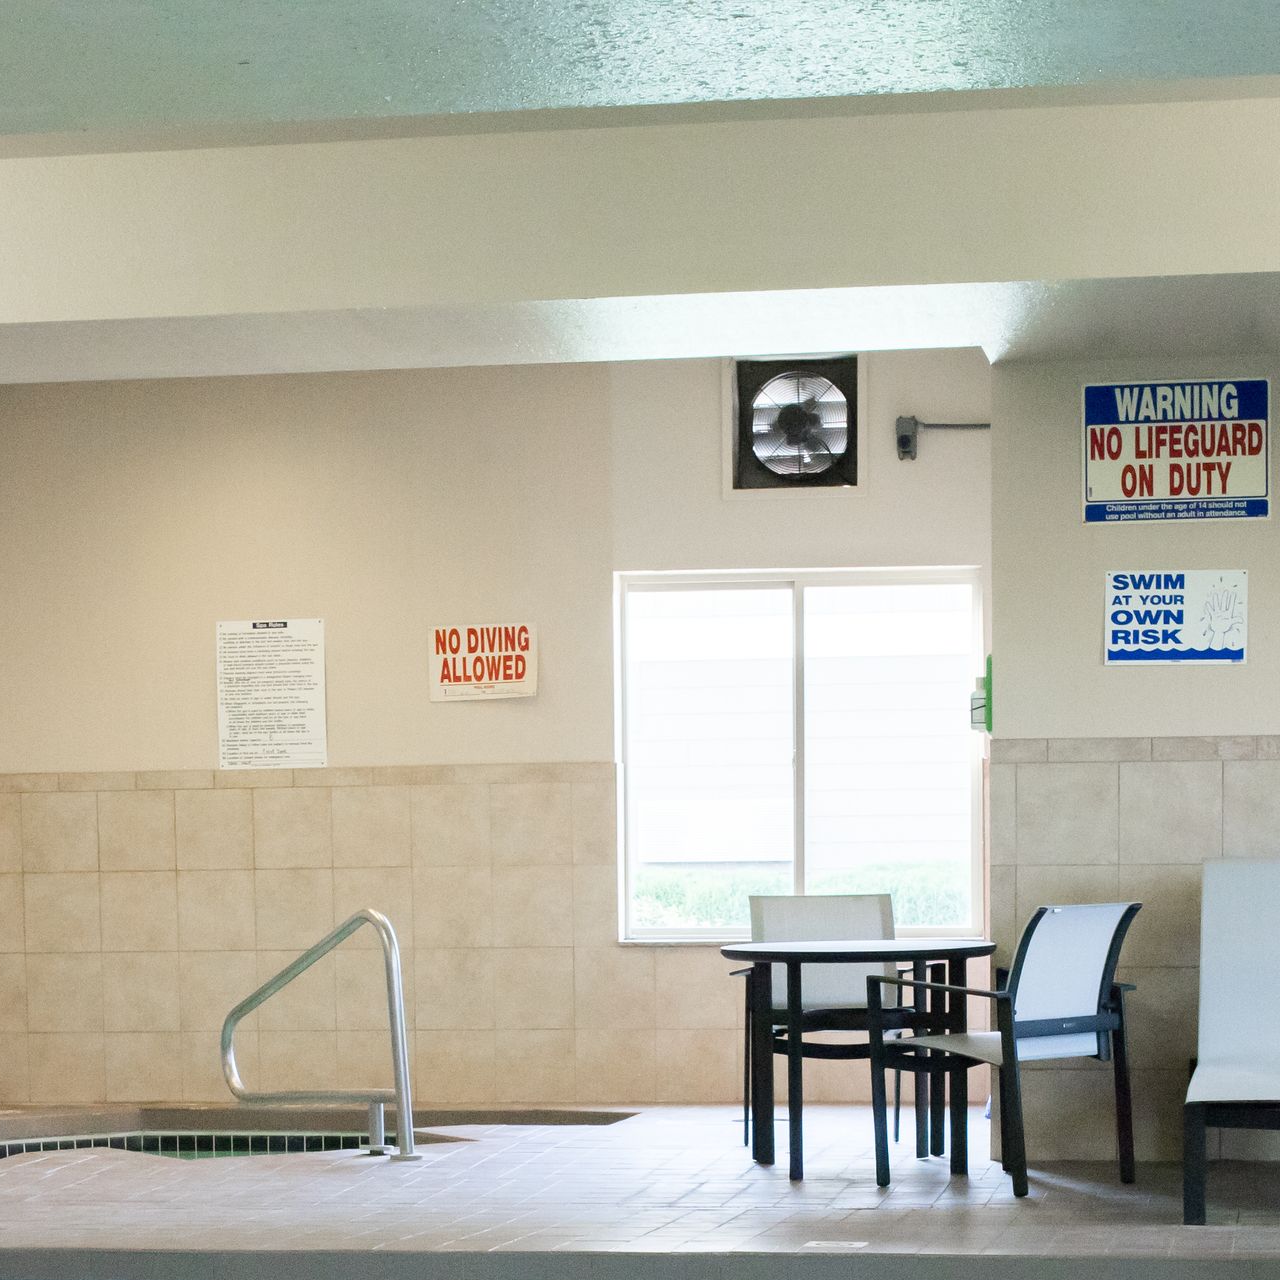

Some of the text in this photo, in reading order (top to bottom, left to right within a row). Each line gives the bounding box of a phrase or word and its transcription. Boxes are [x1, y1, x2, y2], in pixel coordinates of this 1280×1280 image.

[1114, 384, 1239, 422] WARNING
[1090, 423, 1263, 461] NO LIFEGUARD
[1121, 461, 1232, 498] ON DUTY
[1105, 513, 1119, 521] use
[1120, 511, 1137, 522] pool
[1137, 510, 1165, 519] without
[1166, 511, 1176, 519] an
[1176, 509, 1196, 518] adult
[1197, 509, 1204, 518] in
[1106, 504, 1137, 513] Children
[1138, 503, 1160, 511] under
[1161, 502, 1173, 511] the
[1173, 502, 1187, 512] age
[1188, 501, 1197, 510] of
[1208, 500, 1233, 509] should
[1234, 500, 1248, 509] not
[1112, 573, 1185, 591] SWIM
[1111, 594, 1185, 606] AT YOUR
[1110, 609, 1184, 626] OWN
[435, 625, 530, 655] NO DIVING
[1111, 629, 1183, 645] RISK
[440, 654, 527, 683] ALLOWED
